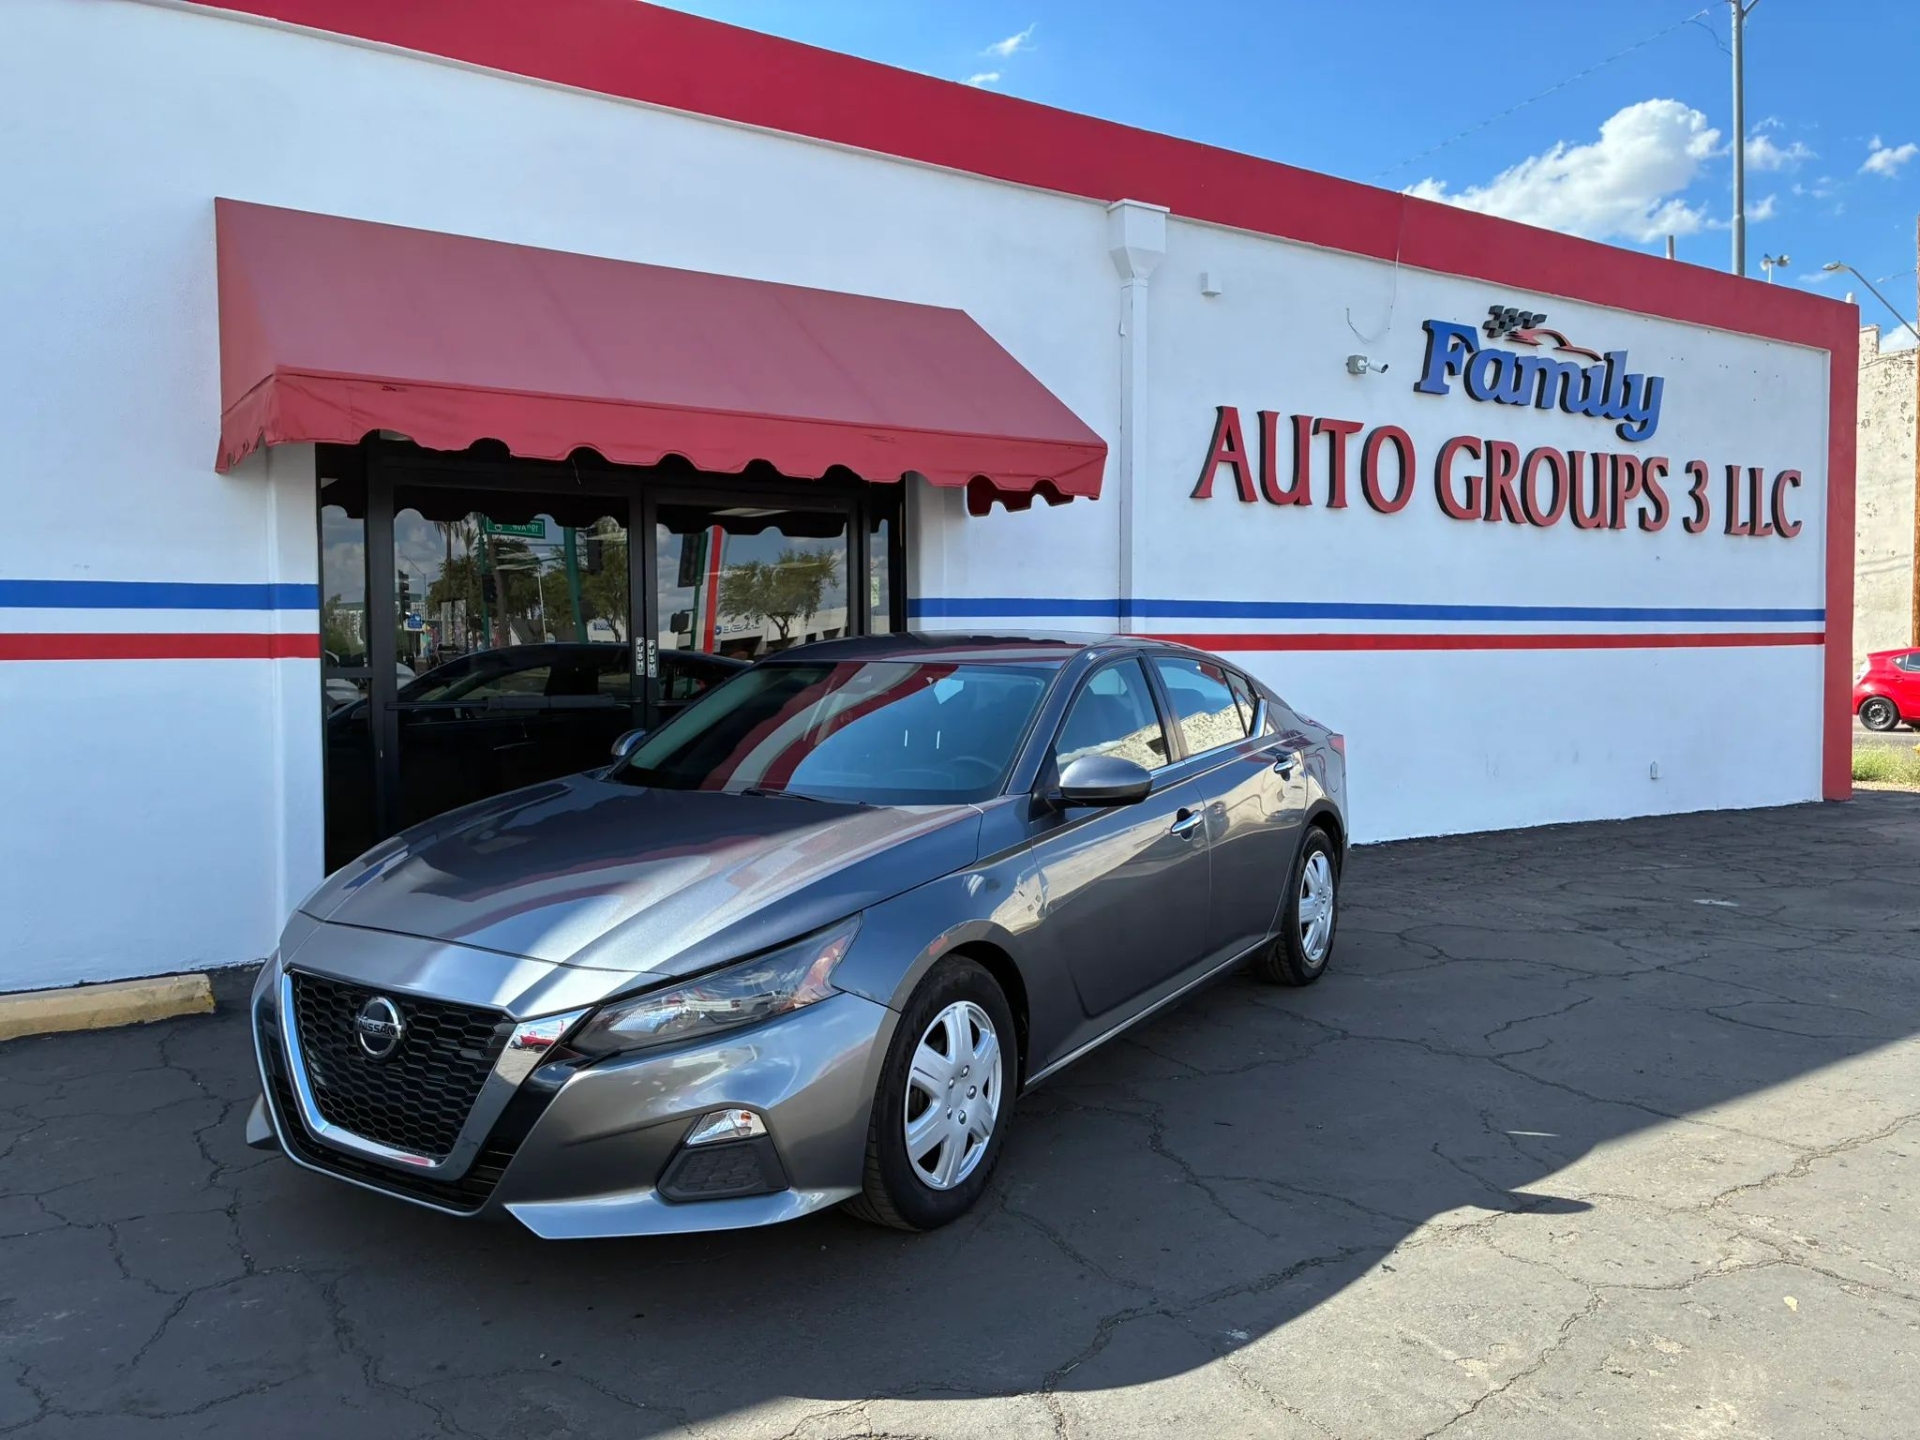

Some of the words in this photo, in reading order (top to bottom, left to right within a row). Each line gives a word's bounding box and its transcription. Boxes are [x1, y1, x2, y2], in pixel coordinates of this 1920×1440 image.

[1414, 319, 1664, 442] Family
[1190, 405, 1416, 514] AUTO
[1434, 435, 1670, 532] GROUPS
[1682, 460, 1711, 534] 3
[1724, 464, 1803, 538] LLC
[648, 641, 656, 671] PUSH
[360, 1020, 395, 1036] NISSAN
